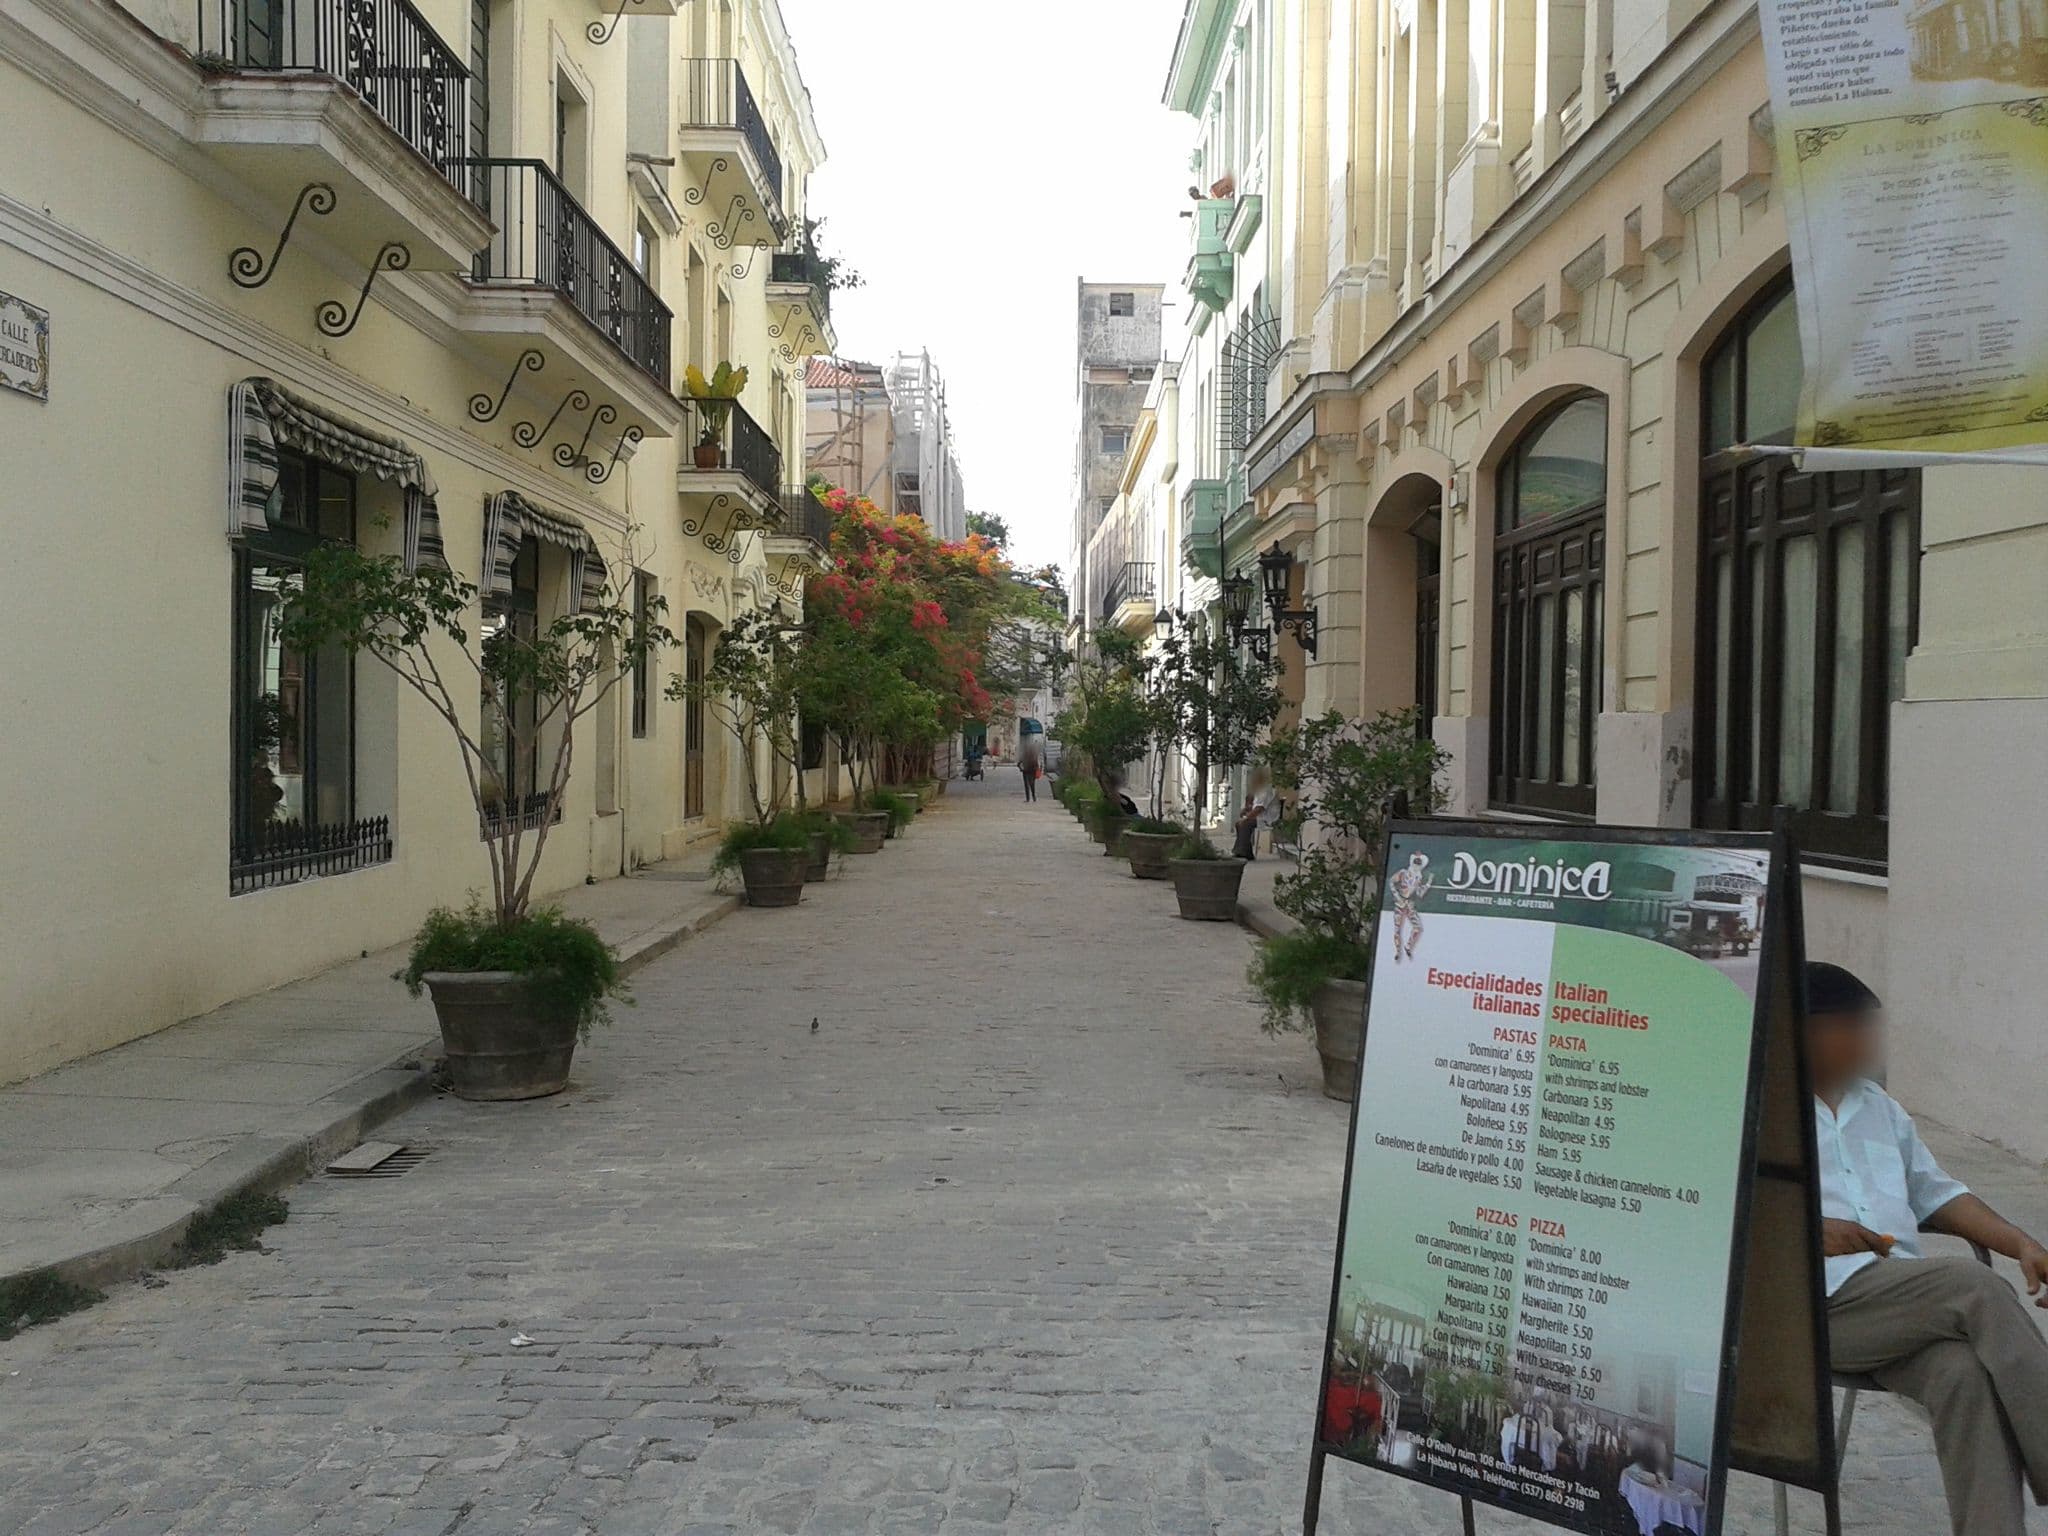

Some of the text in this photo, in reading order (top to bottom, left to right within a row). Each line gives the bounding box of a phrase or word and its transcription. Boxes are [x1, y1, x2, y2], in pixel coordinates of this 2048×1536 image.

[1779, 15, 1796, 24] que
[1800, 7, 1851, 21] preparaba
[1854, 15, 1869, 24] del
[1862, 39, 1874, 48] de
[1784, 57, 1827, 71] obligada
[1858, 51, 1881, 63] para
[1883, 48, 1905, 57] todo
[1787, 65, 1869, 84] aquel viajero que
[1847, 77, 1875, 87] haber
[1835, 92, 1849, 101] La
[1, 319, 28, 343] CALLE
[1446, 894, 1493, 905] RESTAURANTE
[1497, 898, 1512, 907] BAR
[1427, 967, 1543, 998] Especialidades
[1554, 980, 1608, 1005] Italian
[1472, 992, 1541, 1018] italianas
[1551, 1004, 1649, 1031] specialities
[1493, 1026, 1537, 1046] PASTAS
[1549, 1034, 1587, 1052] PASTA
[1516, 1049, 1535, 1063] 6.95
[1434, 1057, 1533, 1081] con camarones y langosta
[1599, 1061, 1619, 1076] 6.95
[1448, 1074, 1532, 1098] A la carbonara 5.95
[1545, 1073, 1649, 1098] with shrimps and lobster
[1460, 1093, 1530, 1117] Napolitana 4.95
[1543, 1088, 1613, 1111] Carbonara 5.95
[1466, 1112, 1528, 1135] Boloñesa 5.95
[1541, 1107, 1615, 1131] Neapolitan 4.95
[1462, 1130, 1526, 1153] De Jamón 5.95
[1539, 1125, 1610, 1149] Bolognese 5.95
[1375, 1132, 1524, 1172] Canelones de embutido y pollo 4.00
[1537, 1144, 1581, 1163] Ham 5.95
[1416, 1158, 1522, 1190] Lasaña de vegetales 5.50
[1535, 1162, 1699, 1204] Sausage & chicken cannelonis 4.00
[1534, 1180, 1641, 1213] Vegetable lasagna 5.50
[1476, 1206, 1518, 1228] PIZZAS
[1530, 1217, 1566, 1238] PIZZA
[1416, 1233, 1514, 1264] con camarones y langosta
[1496, 1231, 1516, 1247] 8.00
[1427, 1251, 1513, 1282] Con camarones 7.00
[1580, 1248, 1602, 1265] 8.00
[1526, 1257, 1630, 1290] with shrimps and lobster
[1447, 1274, 1511, 1301] Hawaiana 7.50
[1524, 1273, 1608, 1304] With shrimps 7.00
[1445, 1293, 1508, 1320] Margarita 5.50
[1521, 1292, 1586, 1319] Hawaiian 7.50
[1438, 1309, 1506, 1338] Napolitana 5.50
[1520, 1311, 1593, 1340] Margherite 5.50
[1433, 1327, 1504, 1357] Con chorizo 6.50
[1518, 1330, 1591, 1360] Neapolitan 5.50
[1422, 1344, 1502, 1376] Cuatro quesos 7.50
[1516, 1348, 1602, 1383] With sausage 6.50
[1514, 1367, 1595, 1401] Four cheeses 7.50
[1407, 1431, 1425, 1446] Calle
[1480, 1453, 1494, 1467] 108
[1495, 1459, 1517, 1474] entre
[1518, 1465, 1566, 1489] Mercaderes
[1567, 1480, 1573, 1493] y
[1575, 1482, 1601, 1499] Tacón
[1417, 1450, 1426, 1462] La
[1428, 1453, 1457, 1471] Habana
[1483, 1470, 1519, 1491] Teléfono:
[1520, 1483, 1544, 1500] (537)
[1545, 1491, 1562, 1504] 860
[1564, 1495, 1585, 1512] 2918
